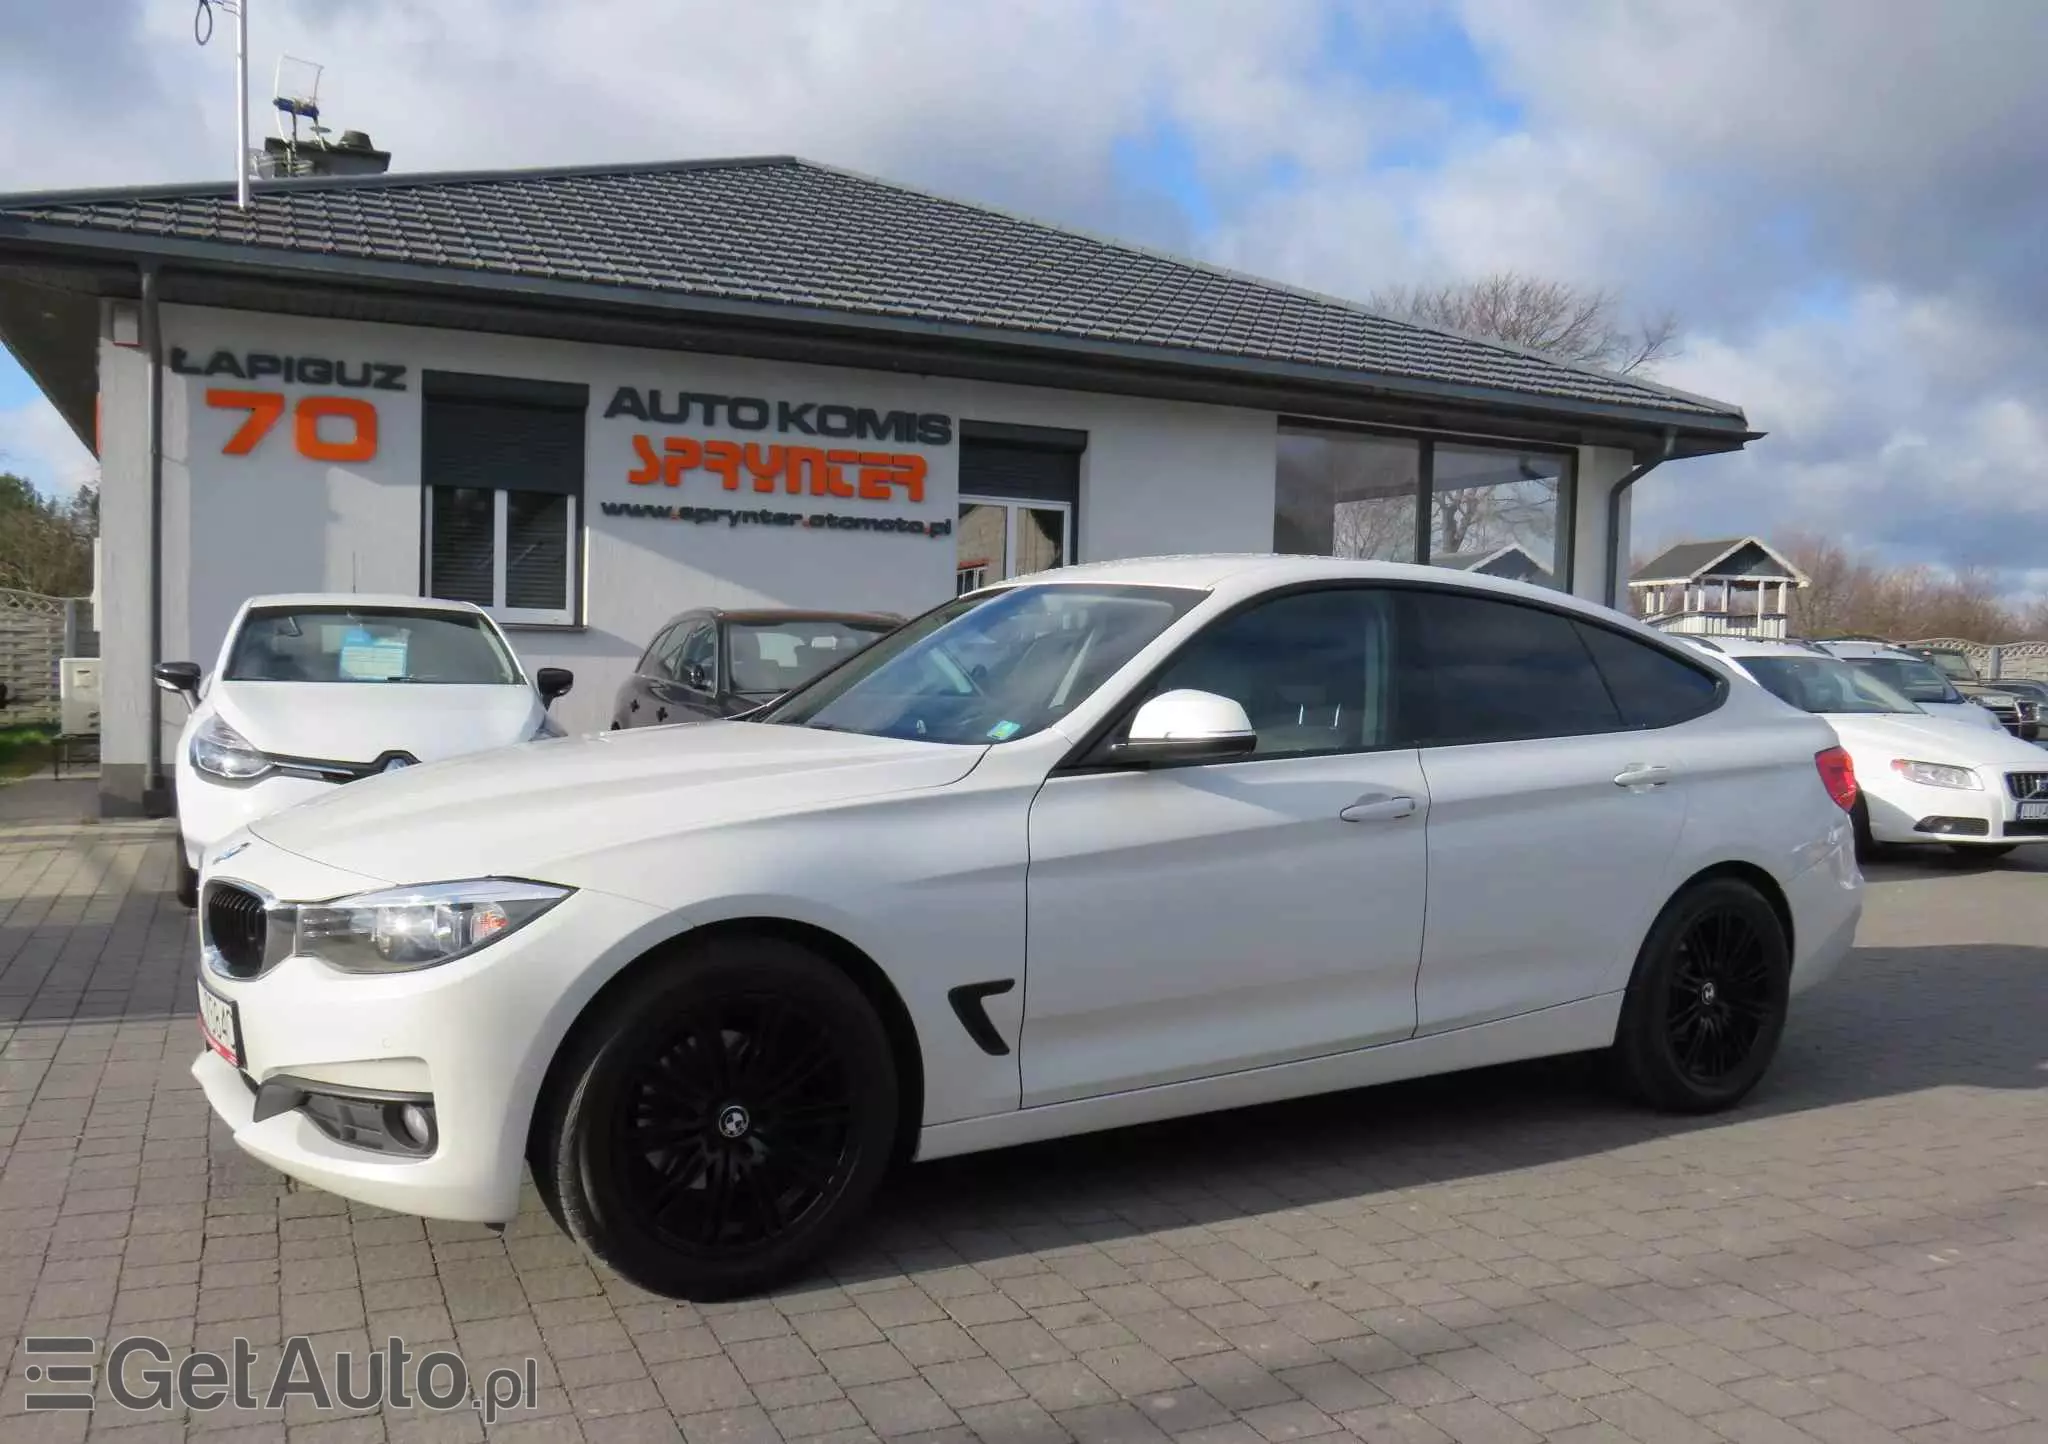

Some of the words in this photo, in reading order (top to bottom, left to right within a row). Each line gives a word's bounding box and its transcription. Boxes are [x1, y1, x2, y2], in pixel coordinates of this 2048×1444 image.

[171, 347, 407, 391] ŁAPIGUZ
[205, 388, 378, 462] 70
[603, 386, 769, 430] AUTO
[777, 401, 952, 446] KOMIS
[628, 434, 927, 502] SPRYNTER
[601, 502, 952, 538] www.sprynter.otomoto.pl
